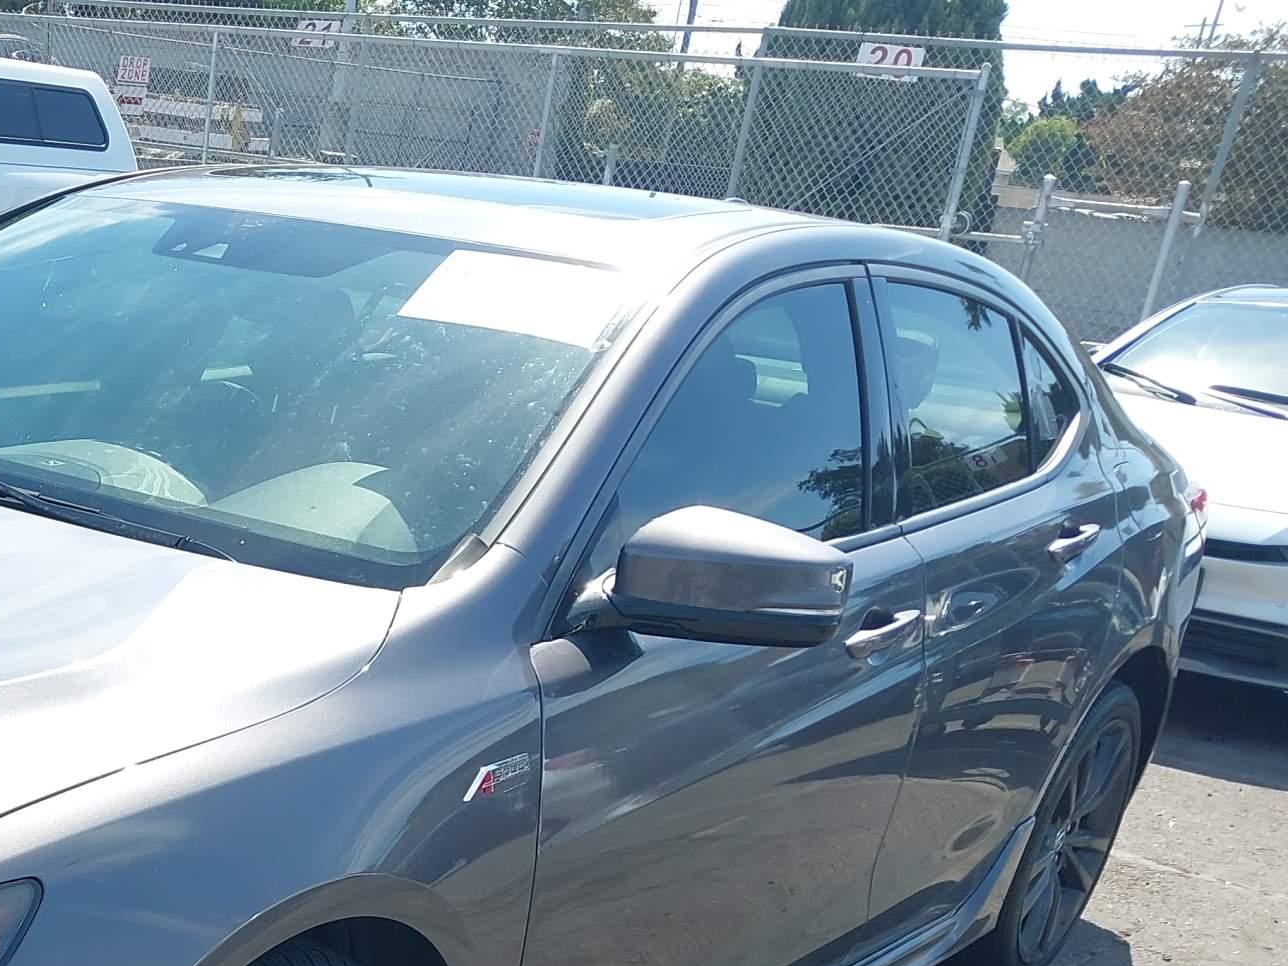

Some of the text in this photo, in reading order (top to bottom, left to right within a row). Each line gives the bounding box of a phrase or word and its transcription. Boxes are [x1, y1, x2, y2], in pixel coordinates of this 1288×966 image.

[298, 21, 333, 46] 21
[121, 56, 149, 69] DROP
[869, 45, 913, 79] 20
[120, 68, 148, 81] ZONE
